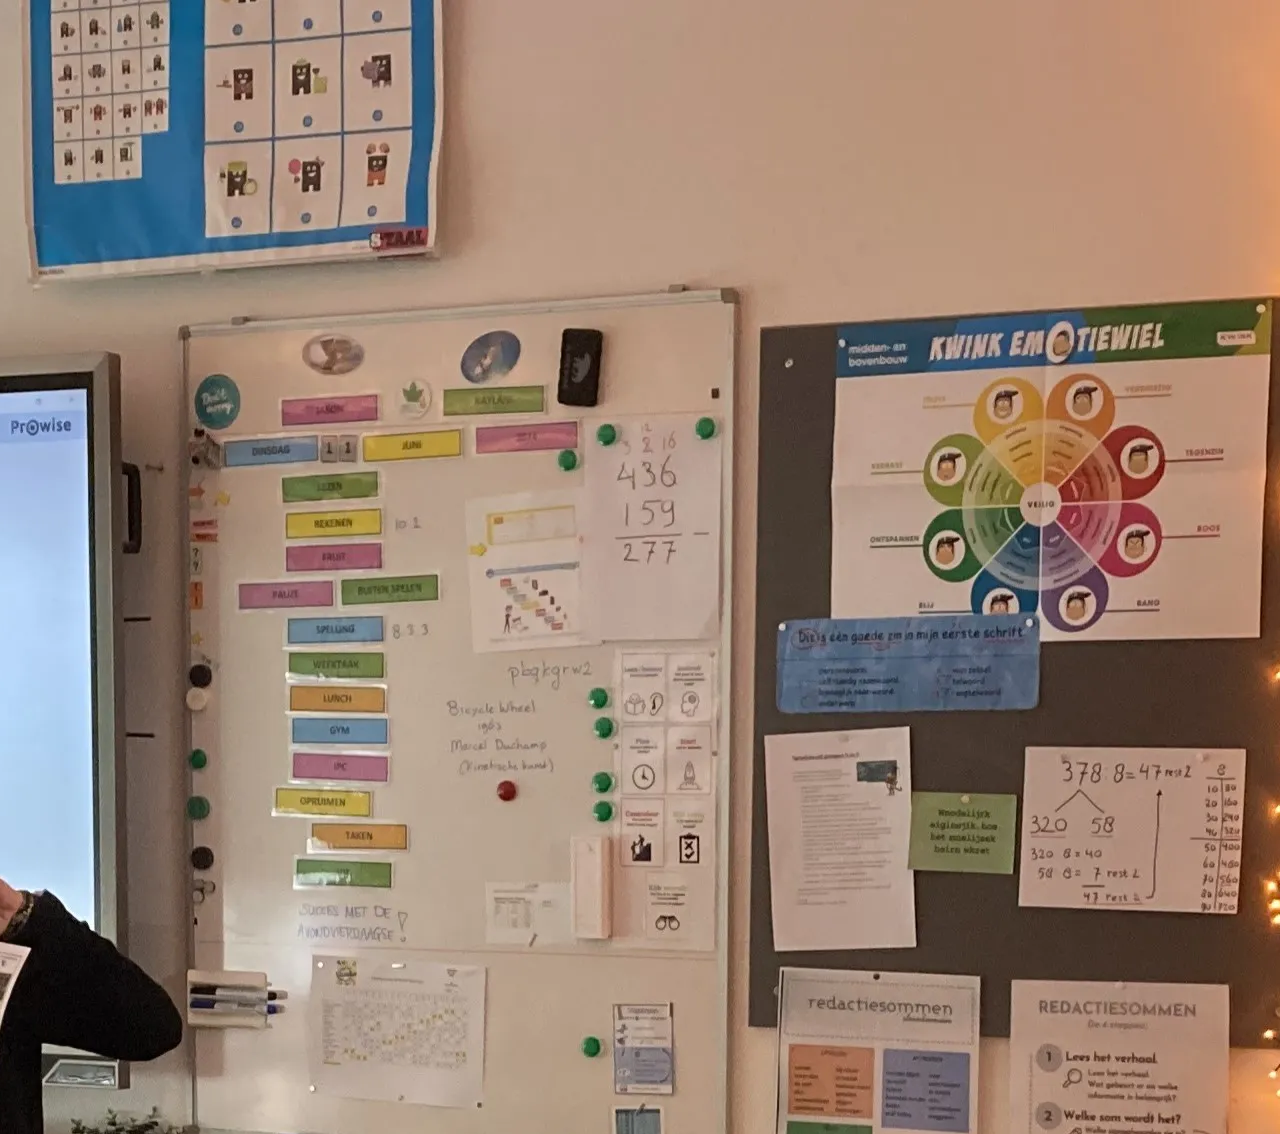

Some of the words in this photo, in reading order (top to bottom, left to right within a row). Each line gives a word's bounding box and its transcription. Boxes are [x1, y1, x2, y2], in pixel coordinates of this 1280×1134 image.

[893, 343, 907, 352] en
[928, 332, 1005, 363] KWINK
[1009, 322, 1165, 364] EMOTIEWIEL
[849, 355, 908, 367] bovenbouw
[252, 447, 290, 456] DINSDAG
[402, 441, 422, 451] JUNI
[617, 455, 677, 490] 436
[624, 499, 676, 528] 159
[314, 518, 353, 529] REKENEN
[322, 553, 346, 561] FRUIT
[623, 541, 677, 565] 277
[323, 694, 352, 704] LUNCH
[330, 725, 350, 735] GYM
[1062, 760, 1102, 786] 378
[1139, 762, 1162, 780] 47
[1184, 764, 1192, 778] 2
[300, 797, 346, 807] OPRUIMEN
[1030, 816, 1067, 834] 320
[1091, 816, 1115, 834] 58
[345, 831, 373, 841] TAKEN
[1031, 849, 1053, 860] 320
[345, 906, 368, 918] MET
[374, 905, 392, 919] DE
[807, 995, 953, 1016] redactiesommen
[1039, 1000, 1196, 1018] REDACTIESOMMEN
[1046, 1052, 1052, 1062] 1
[1066, 1051, 1090, 1062] Lees
[1094, 1050, 1111, 1062] het
[1044, 1111, 1053, 1121] 2
[1064, 1110, 1096, 1121] Welke
[1124, 1113, 1154, 1124] wordt
[1158, 1113, 1181, 1124] het?
